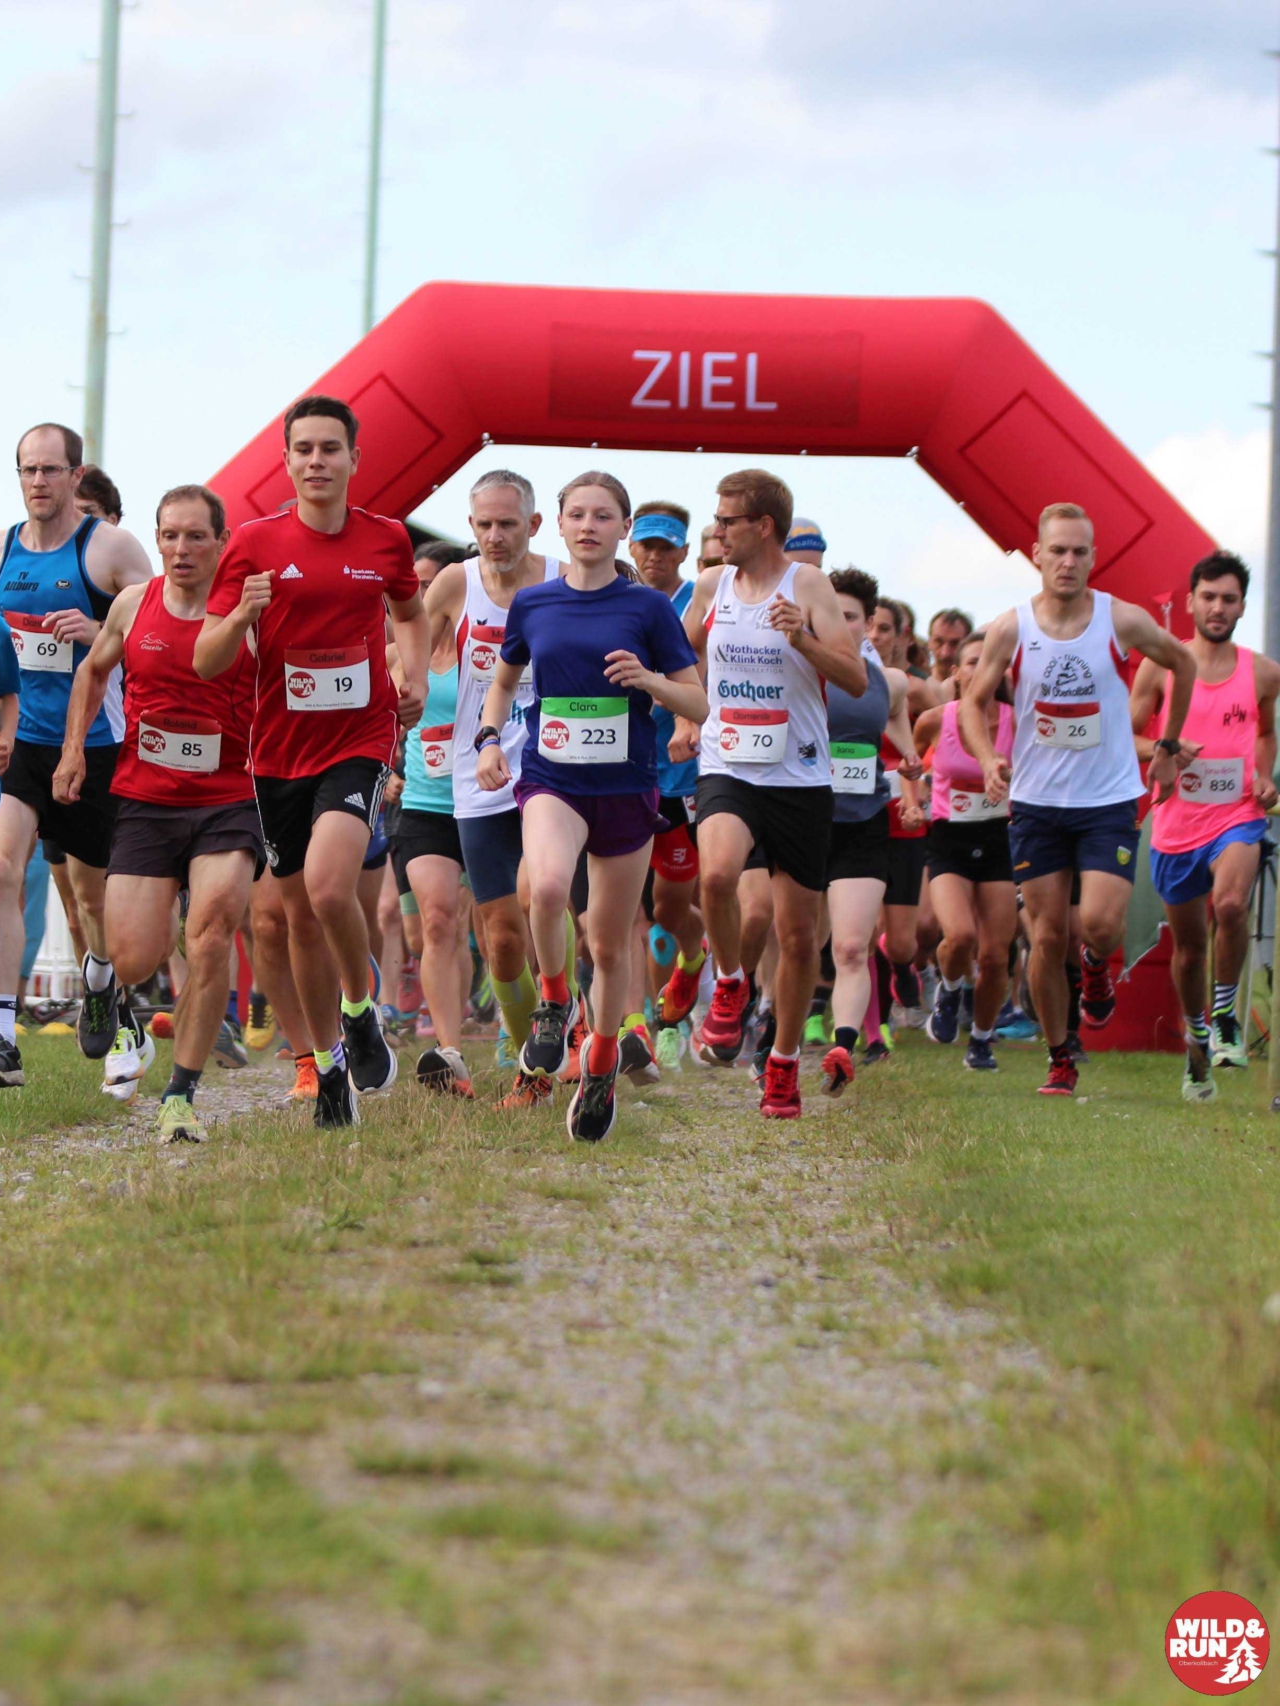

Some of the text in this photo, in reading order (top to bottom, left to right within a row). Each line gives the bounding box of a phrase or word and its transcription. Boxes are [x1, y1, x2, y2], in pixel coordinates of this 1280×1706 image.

[631, 350, 778, 410] ZIEL
[17, 571, 29, 580] TV
[280, 572, 303, 580] adidas
[3, 581, 40, 592] Altburg
[36, 642, 58, 657] 69
[726, 643, 782, 655] Nothacker
[309, 652, 345, 663] Gabriel
[730, 654, 782, 665] Klink Koch
[1043, 656, 1058, 678] cool
[1064, 654, 1092, 679] running
[289, 677, 314, 685] WILD&
[334, 676, 353, 692] 19
[718, 679, 784, 701] Gothaer
[569, 701, 598, 712] Clara
[733, 711, 771, 721] Domenik
[1222, 703, 1247, 727] RUN
[163, 718, 197, 730] Roland
[544, 727, 568, 735] WILD&
[581, 728, 616, 745] 223
[1068, 724, 1087, 737] 26
[752, 734, 773, 748] 70
[181, 742, 203, 757] 85
[842, 766, 869, 780] 226
[1210, 779, 1235, 791] 836
